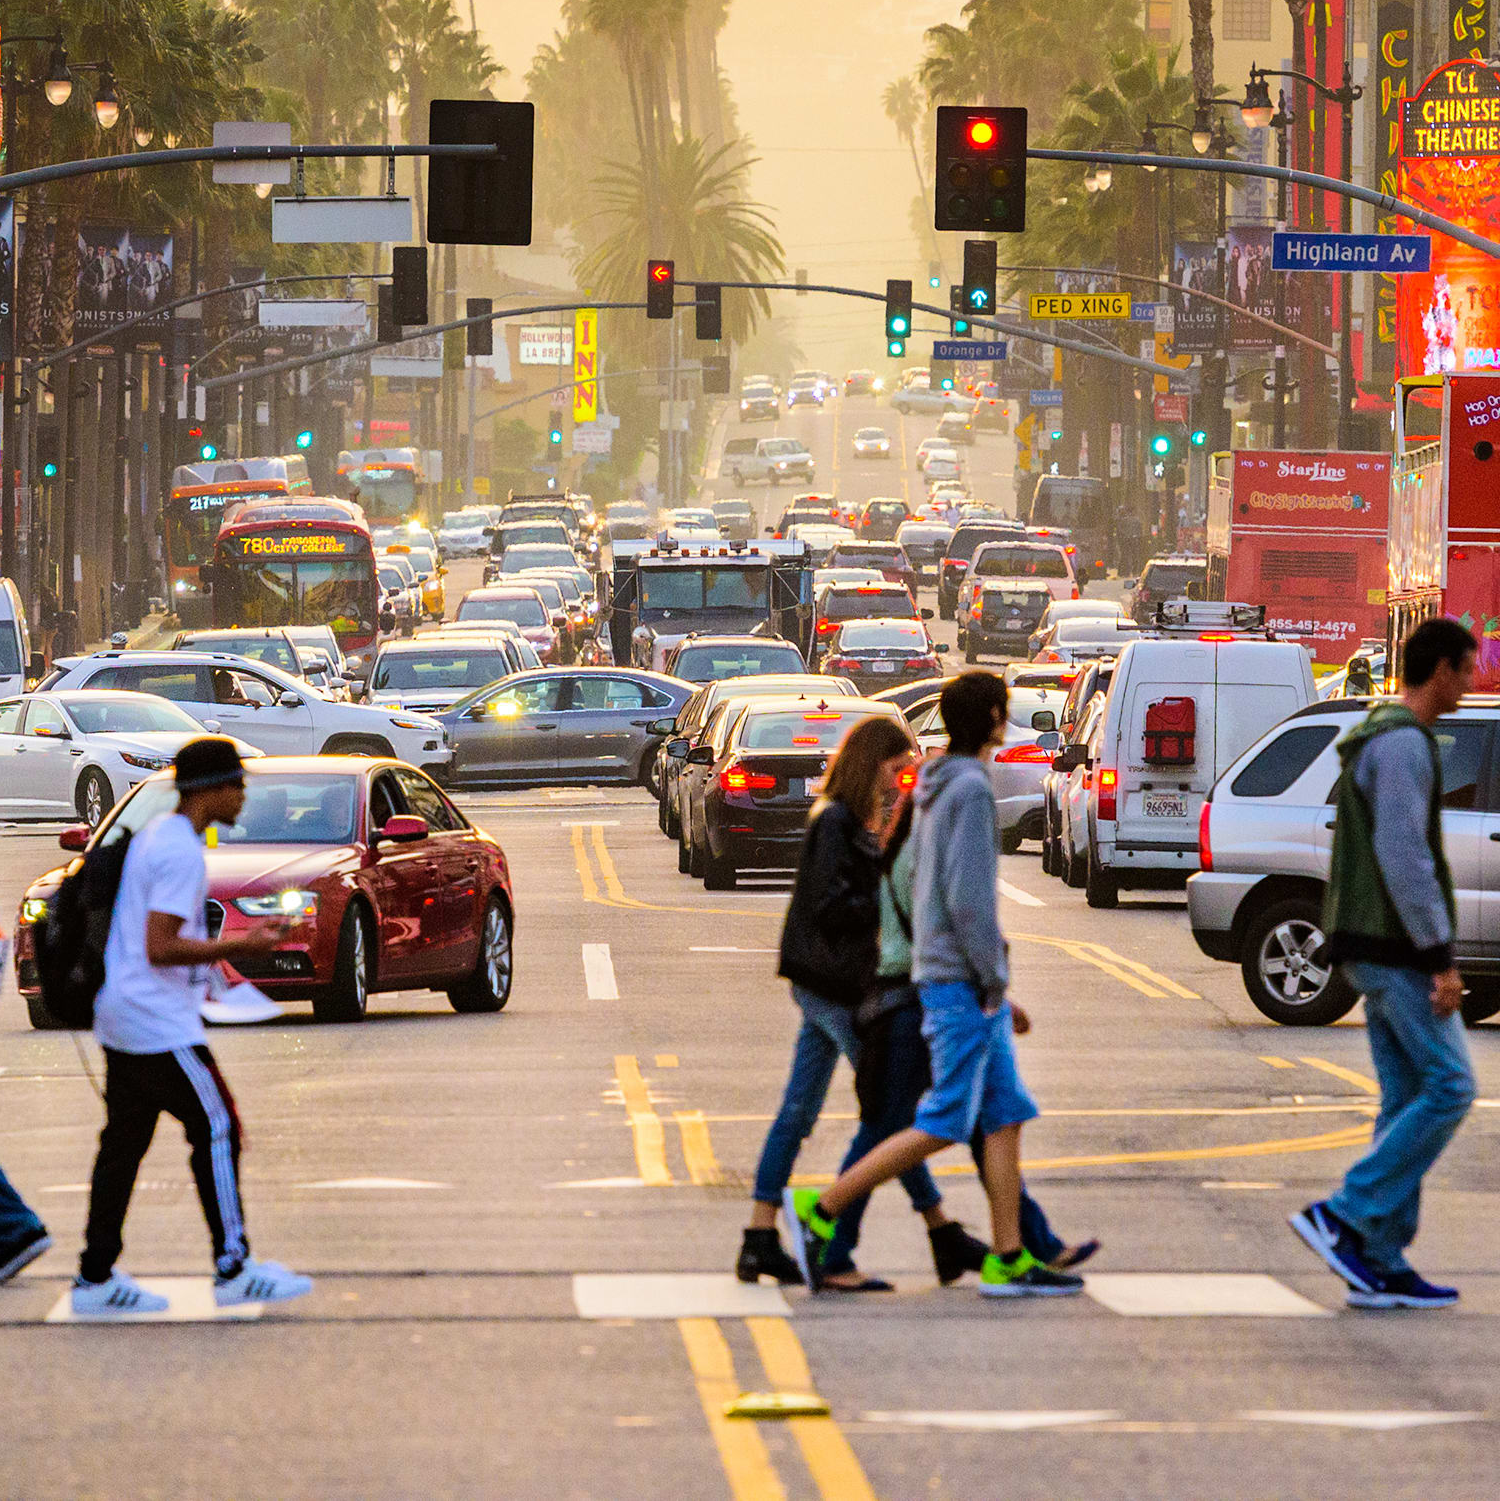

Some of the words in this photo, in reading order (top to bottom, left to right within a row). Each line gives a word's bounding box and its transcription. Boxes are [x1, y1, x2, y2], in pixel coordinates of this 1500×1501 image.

[1445, 70, 1479, 94] TCL
[1422, 98, 1500, 124] CHINESE
[1286, 241, 1379, 267] Highland
[1390, 243, 1417, 263] Av
[1036, 299, 1072, 314] PED
[1081, 298, 1123, 313] XING
[520, 331, 572, 344] HOLLYWOOD
[541, 347, 566, 358] BREA
[939, 345, 983, 358] Orange
[987, 344, 1001, 356] Dr
[575, 320, 595, 409] INN
[1464, 398, 1487, 414] Hop
[1468, 411, 1490, 427] Hop
[189, 496, 208, 511] 217
[239, 537, 275, 554] 780
[273, 544, 299, 554] CITY
[301, 543, 346, 553] COLLEGE
